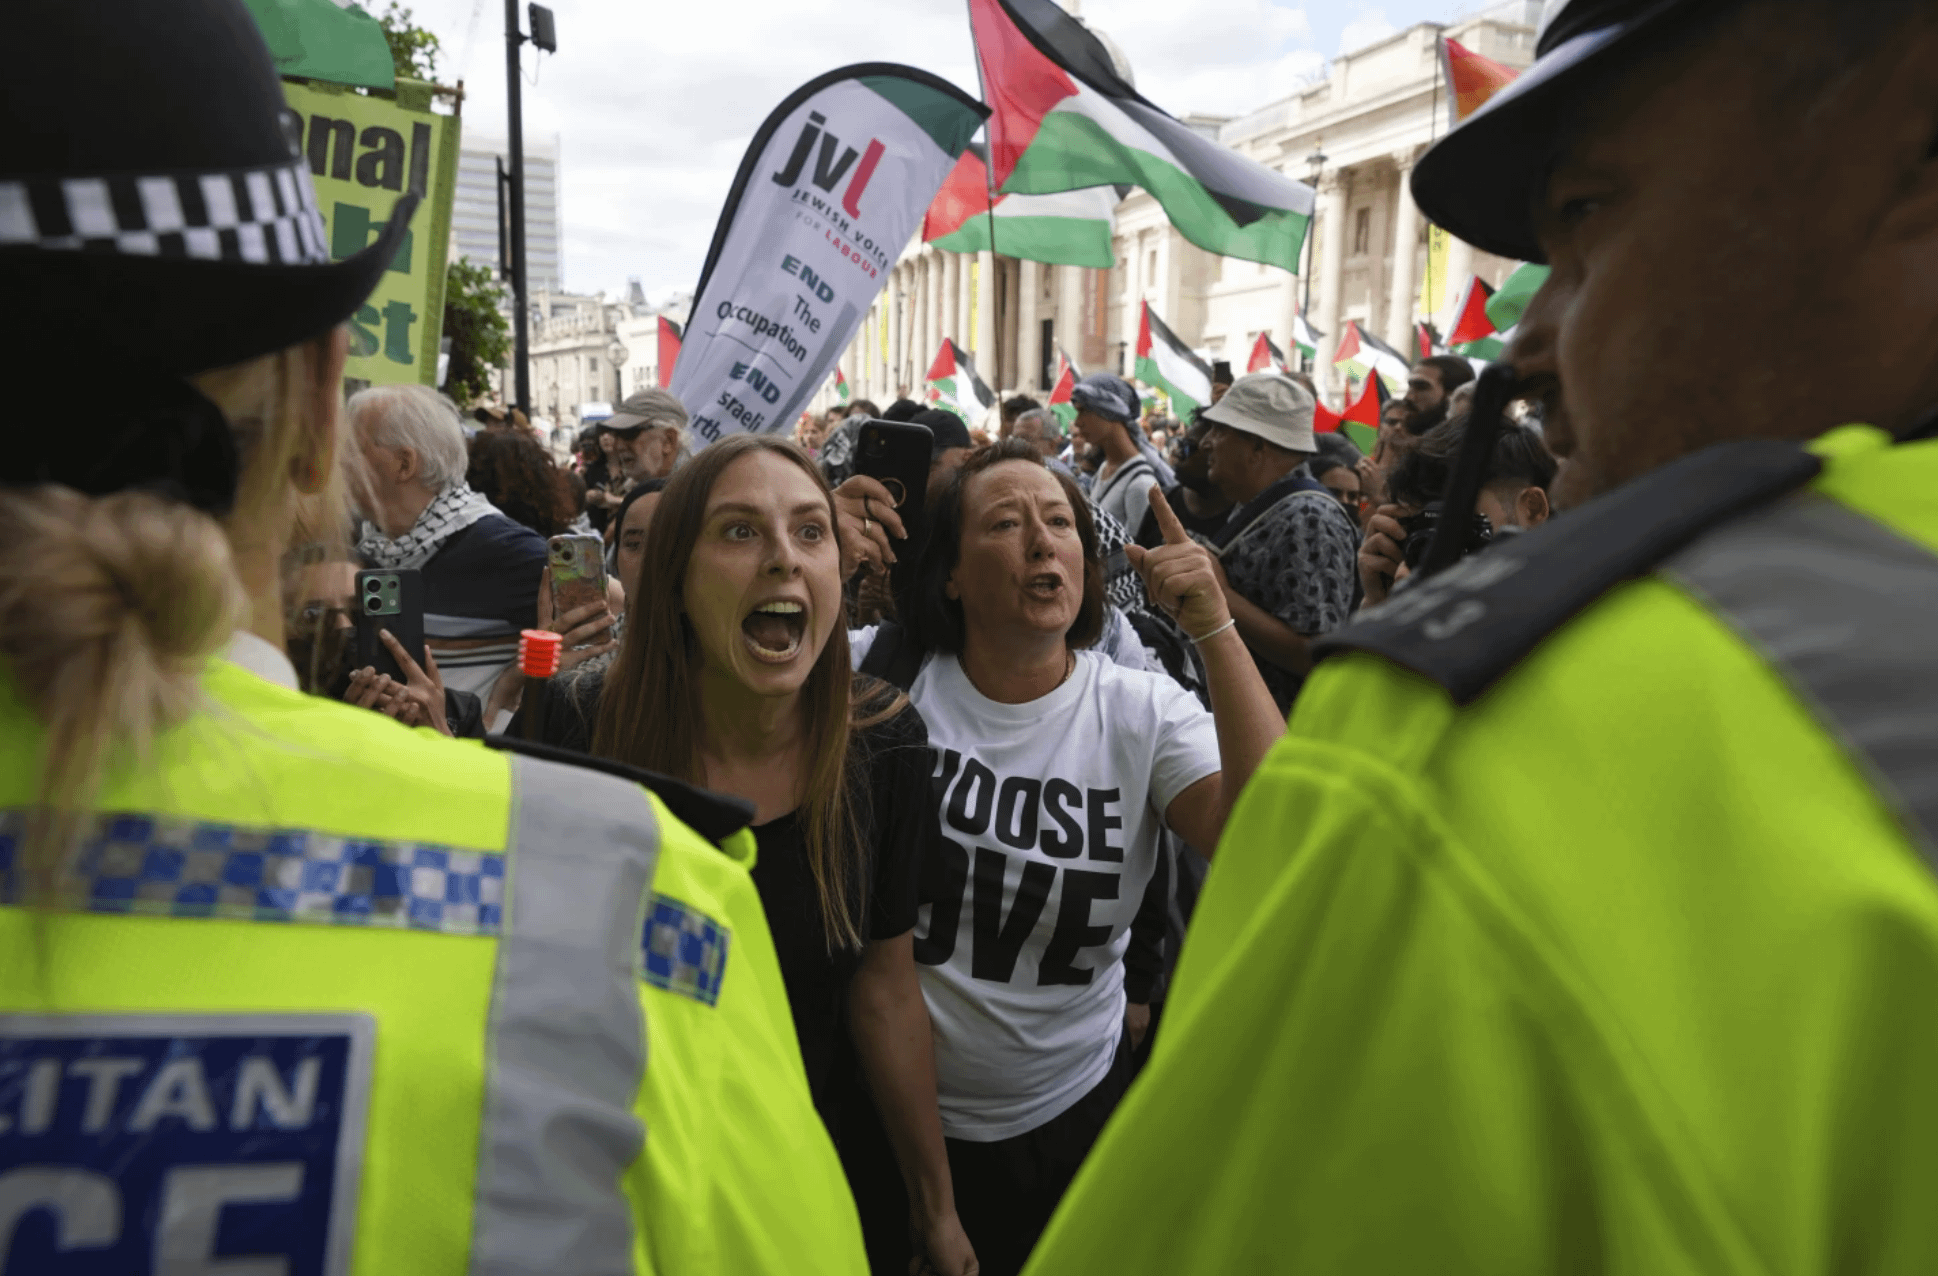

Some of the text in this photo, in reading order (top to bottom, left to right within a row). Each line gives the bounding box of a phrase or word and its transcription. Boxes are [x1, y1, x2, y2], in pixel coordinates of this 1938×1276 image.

[771, 110, 886, 220] jvl
[792, 188, 849, 231] JEWISH
[796, 211, 878, 278] FOR LABOUR
[780, 254, 834, 303] END
[717, 301, 807, 362] Occupation
[793, 294, 821, 334] The
[729, 361, 780, 404] END
[692, 413, 721, 442] rth
[0, 1056, 322, 1134] ITAN
